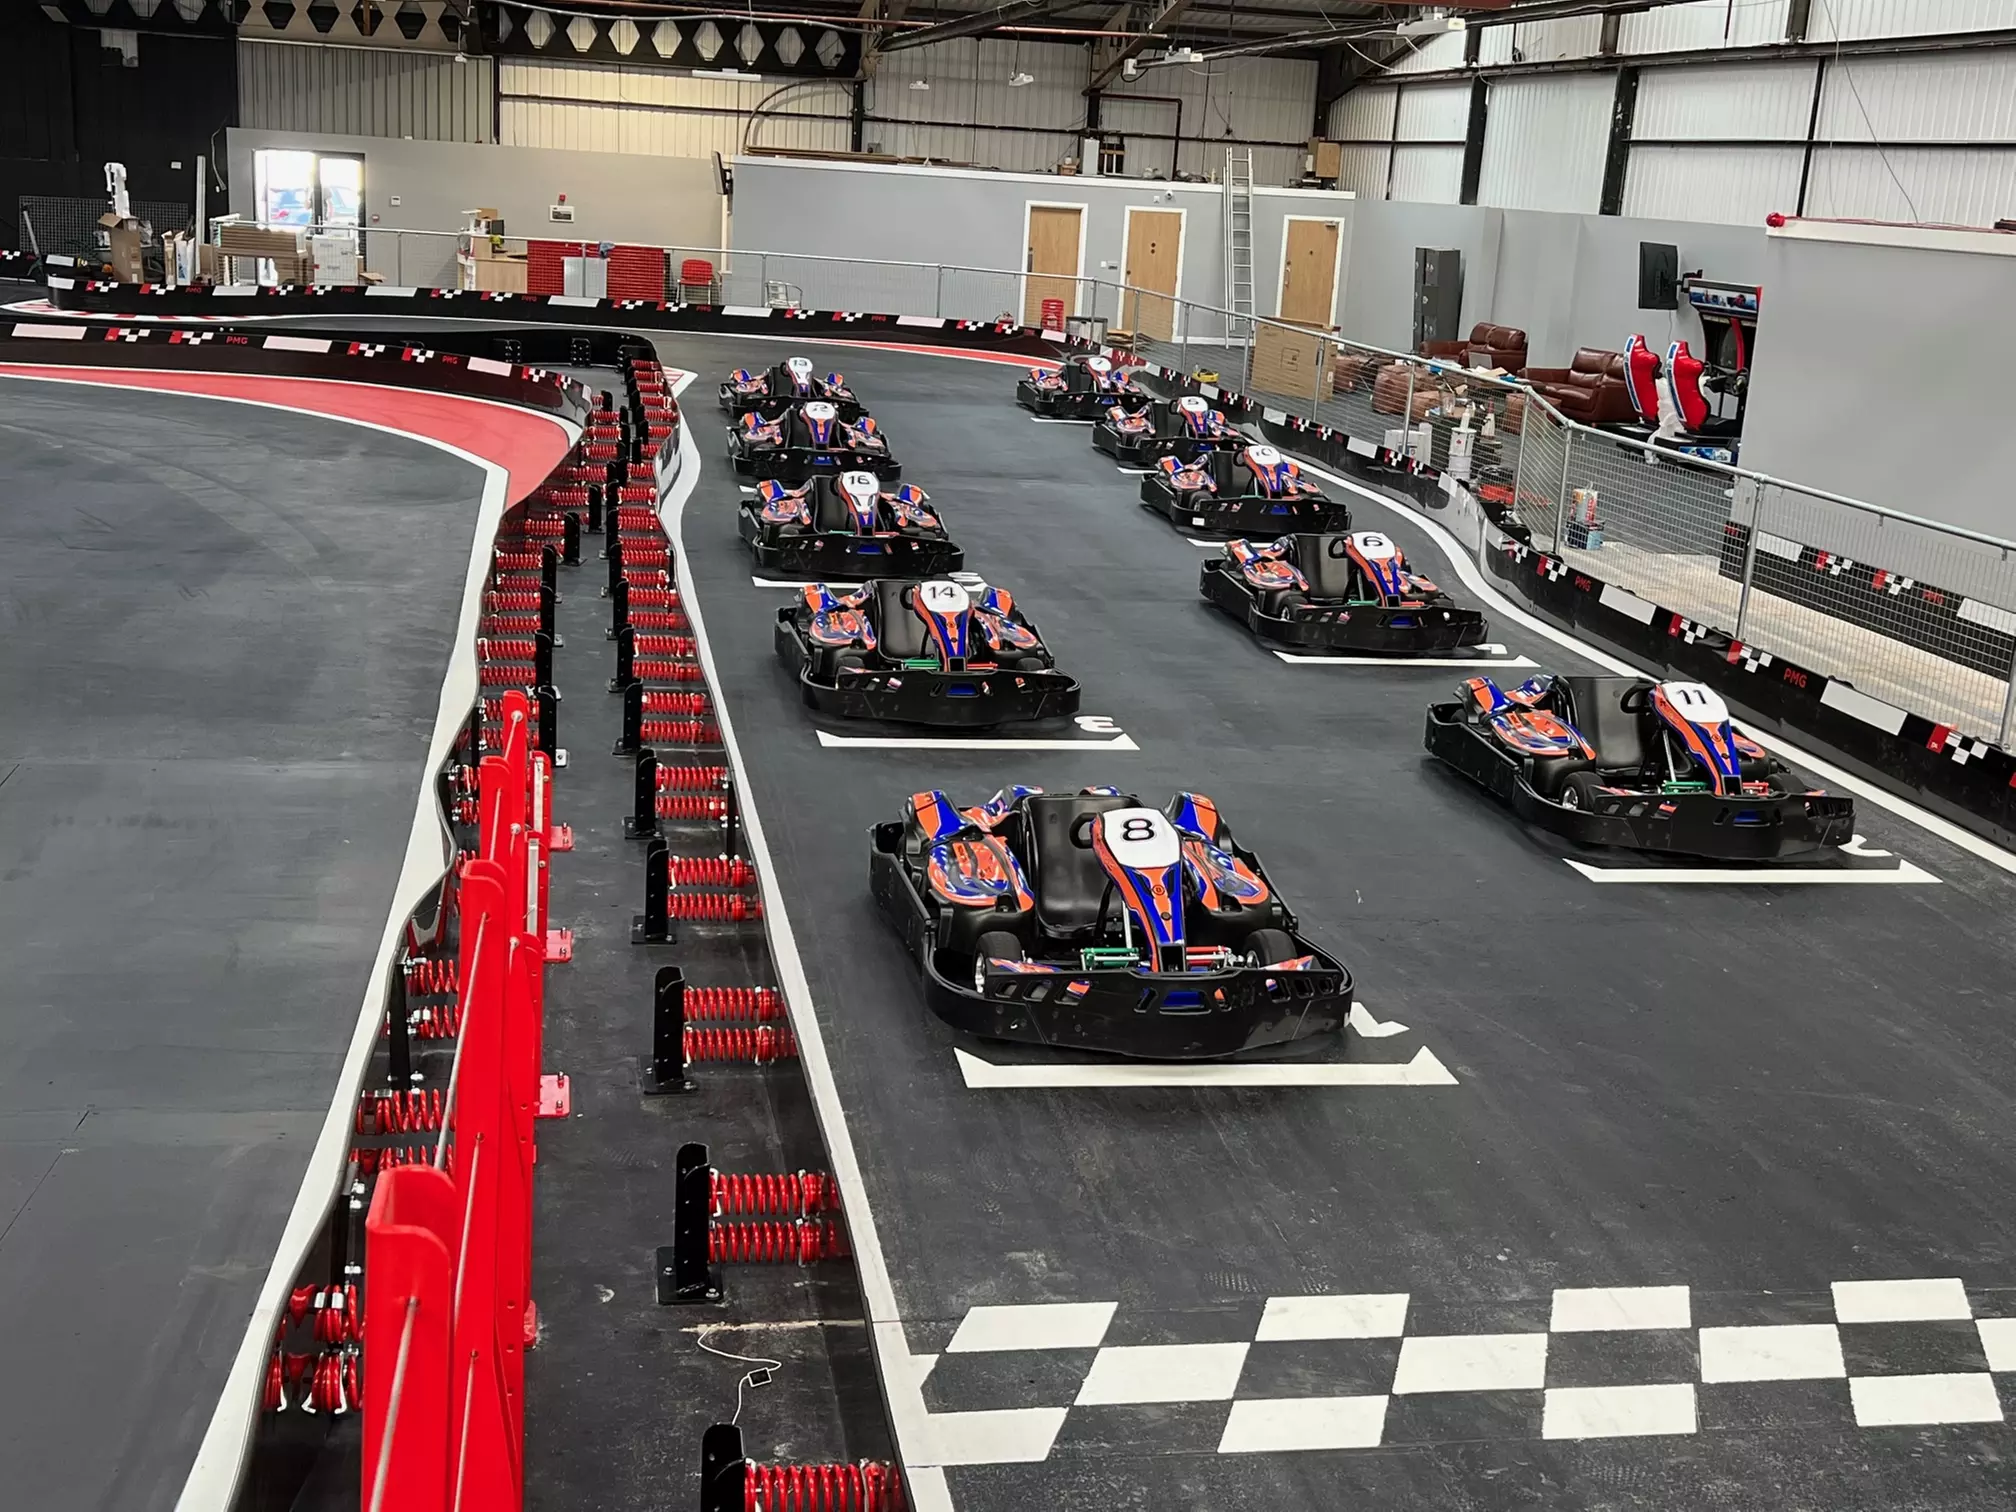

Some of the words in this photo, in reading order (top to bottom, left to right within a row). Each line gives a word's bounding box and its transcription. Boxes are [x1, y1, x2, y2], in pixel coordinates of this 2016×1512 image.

[226, 335, 249, 344] PMG
[848, 475, 870, 485] 16
[1363, 536, 1384, 546] 6
[1575, 575, 1592, 592] PMG
[928, 586, 957, 599] 14
[1783, 667, 1808, 688] PMG
[1676, 689, 1708, 705] 11
[1121, 818, 1154, 842] 8
